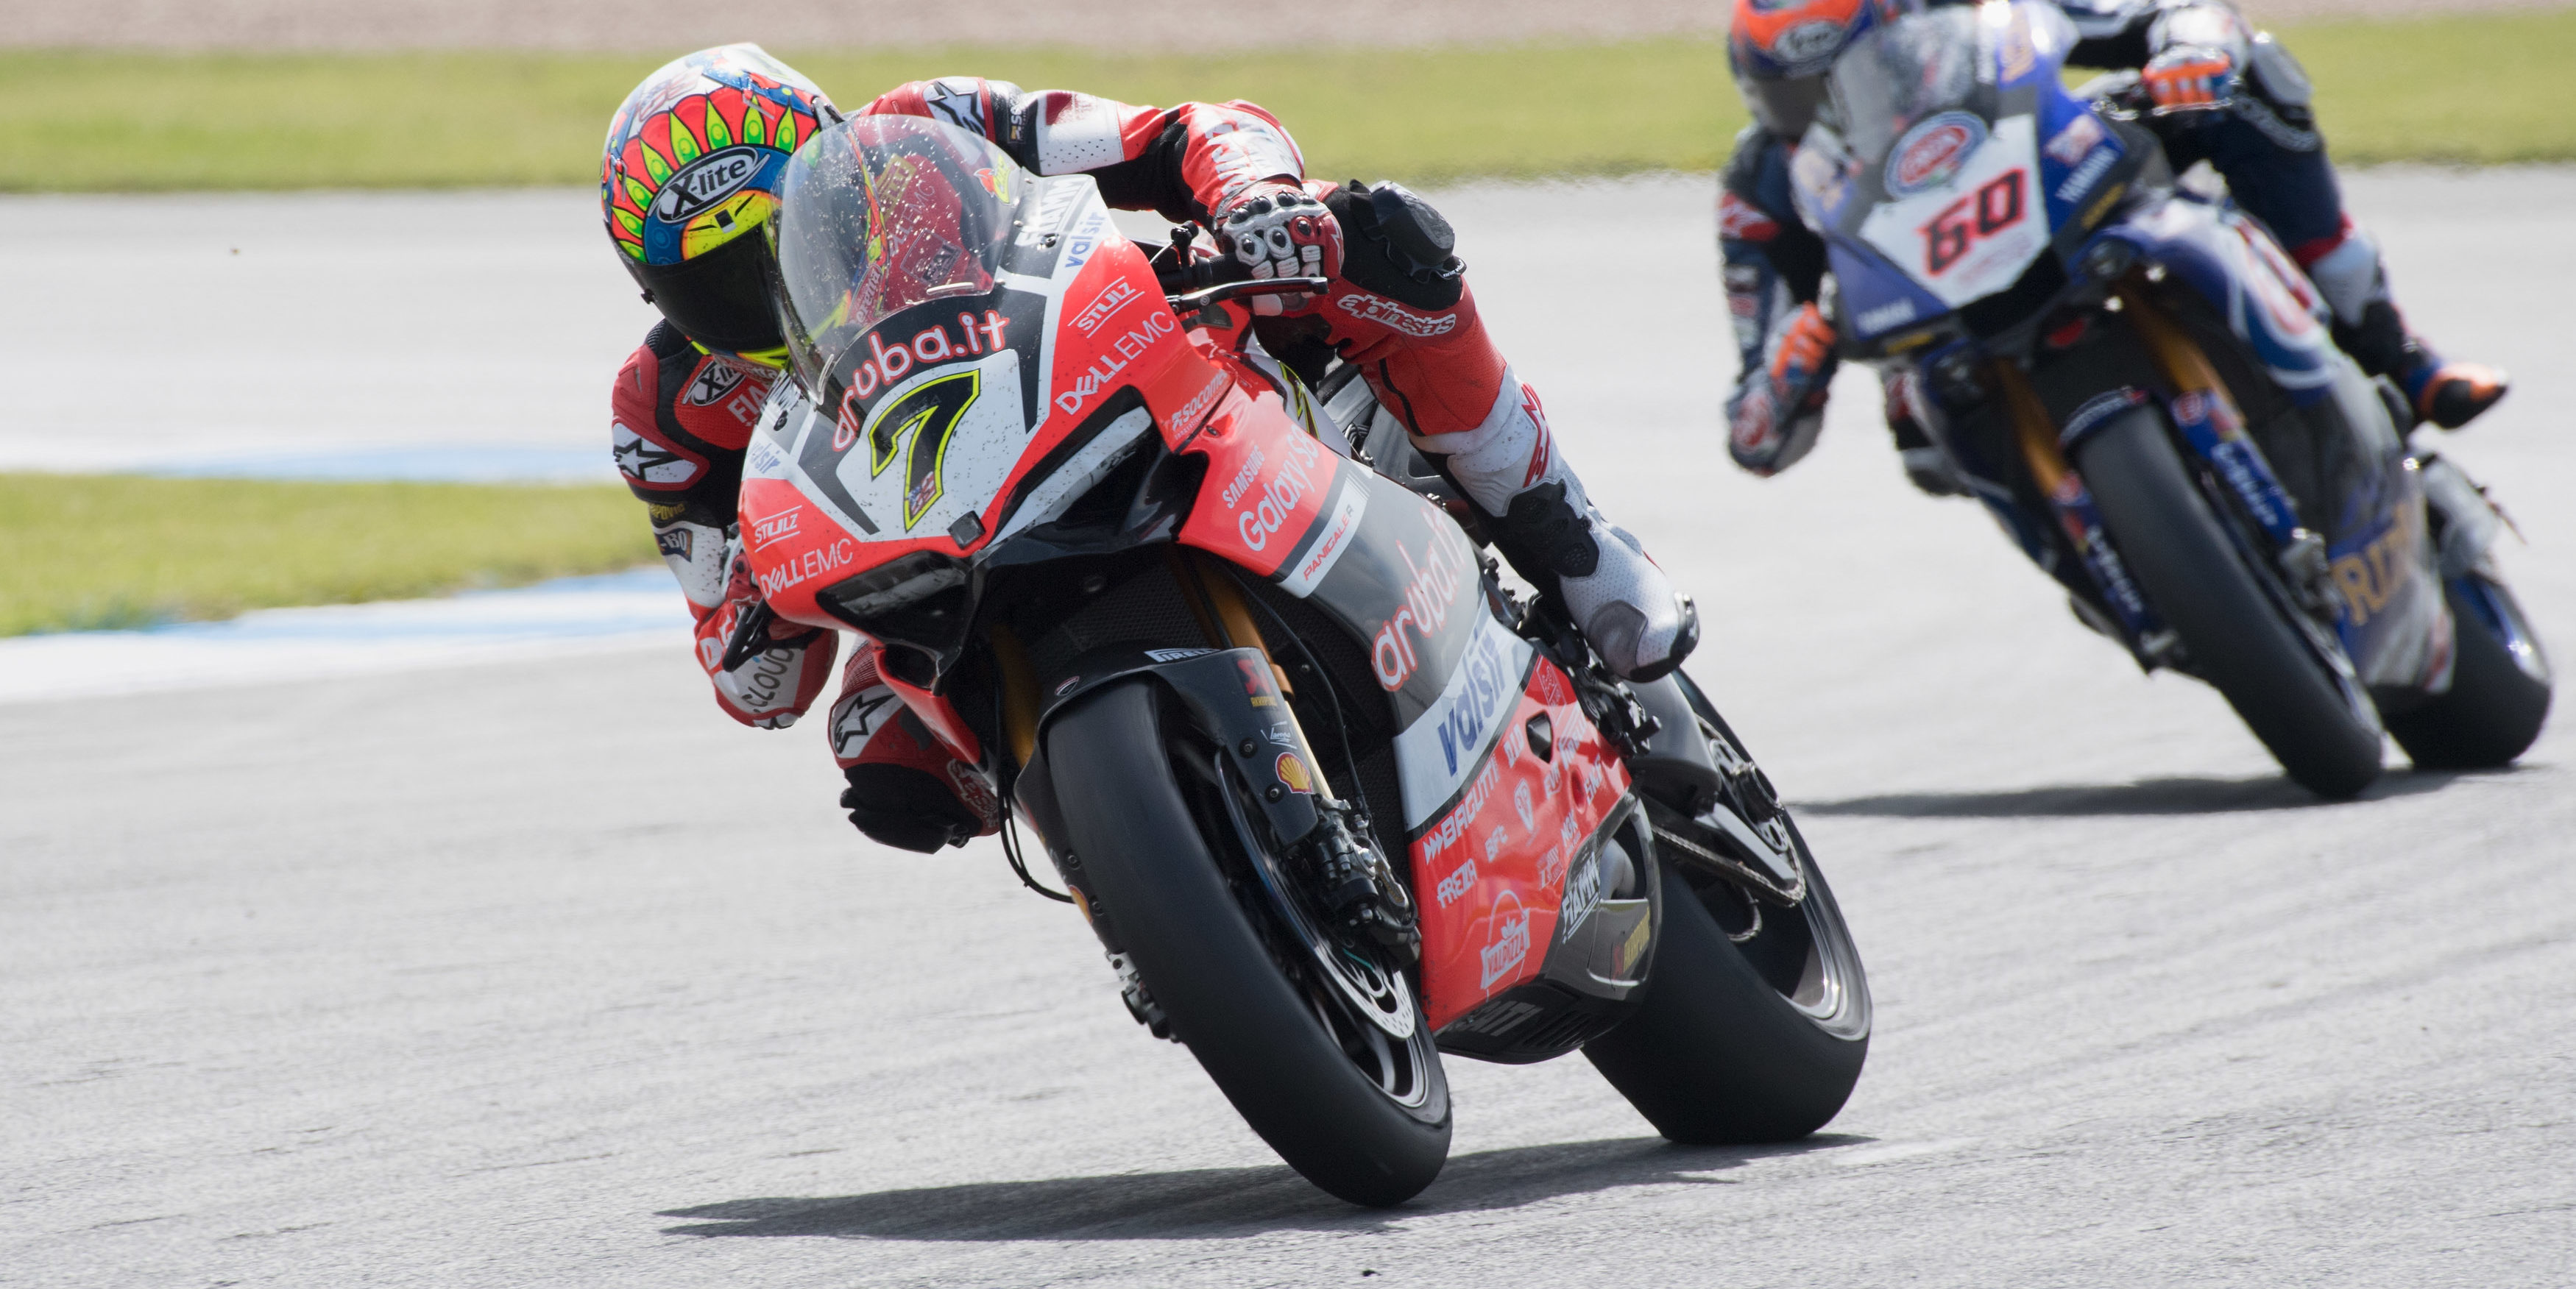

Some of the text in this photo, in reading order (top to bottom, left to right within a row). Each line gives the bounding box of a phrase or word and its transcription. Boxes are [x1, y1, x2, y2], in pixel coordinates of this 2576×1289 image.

[669, 158, 747, 218] X-lite
[1917, 166, 2027, 277] 60
[1065, 211, 1108, 268] valsir
[1077, 281, 1136, 331] STULZ
[832, 310, 1010, 452] aruba.it
[868, 368, 980, 533] 7
[1222, 445, 1265, 509] SAMSUNG
[1238, 425, 1320, 552] Galaxy S8
[754, 513, 799, 544] STULZ
[1303, 516, 1350, 580] PANIGALE
[1371, 506, 1466, 693] aruba.it
[1437, 627, 1506, 778] valsir
